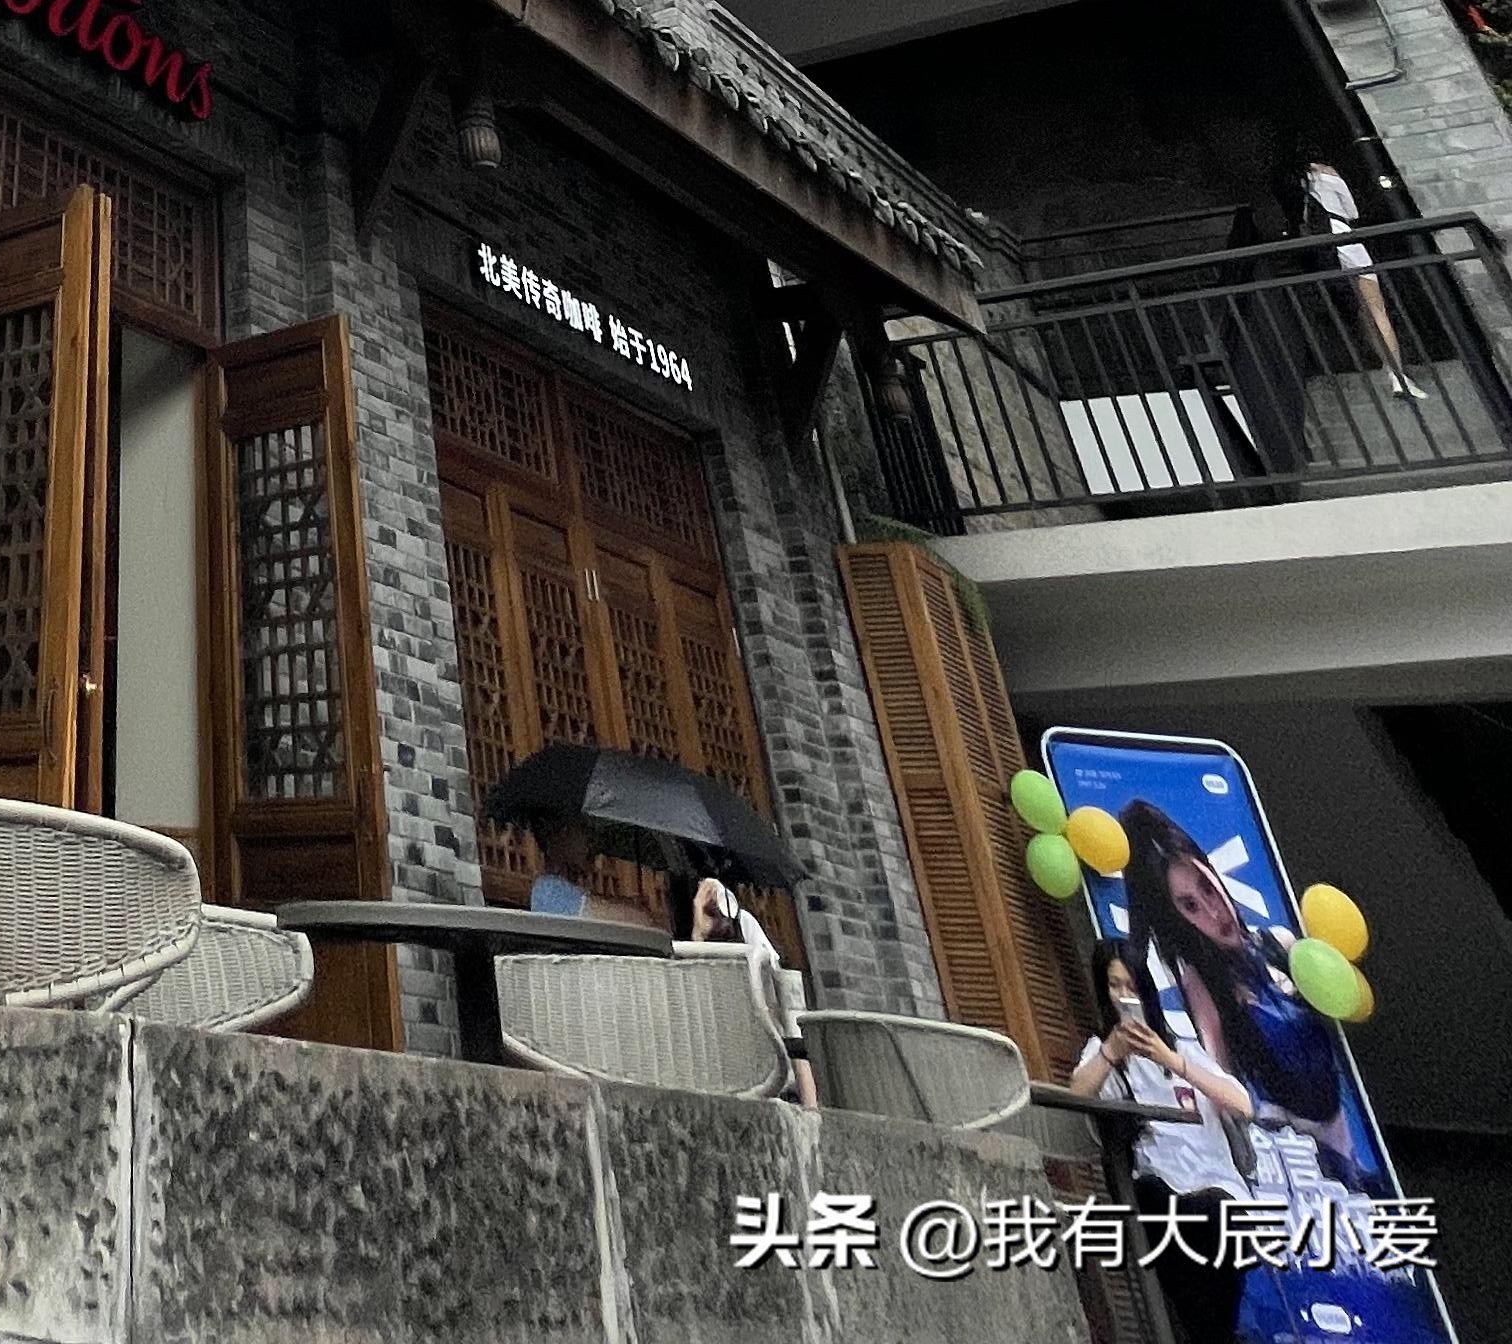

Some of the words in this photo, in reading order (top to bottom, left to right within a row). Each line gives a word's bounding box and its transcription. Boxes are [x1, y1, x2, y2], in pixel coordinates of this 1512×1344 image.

[478, 243, 602, 343] 北美传奇咖啡
[609, 315, 692, 391] 始于1964
